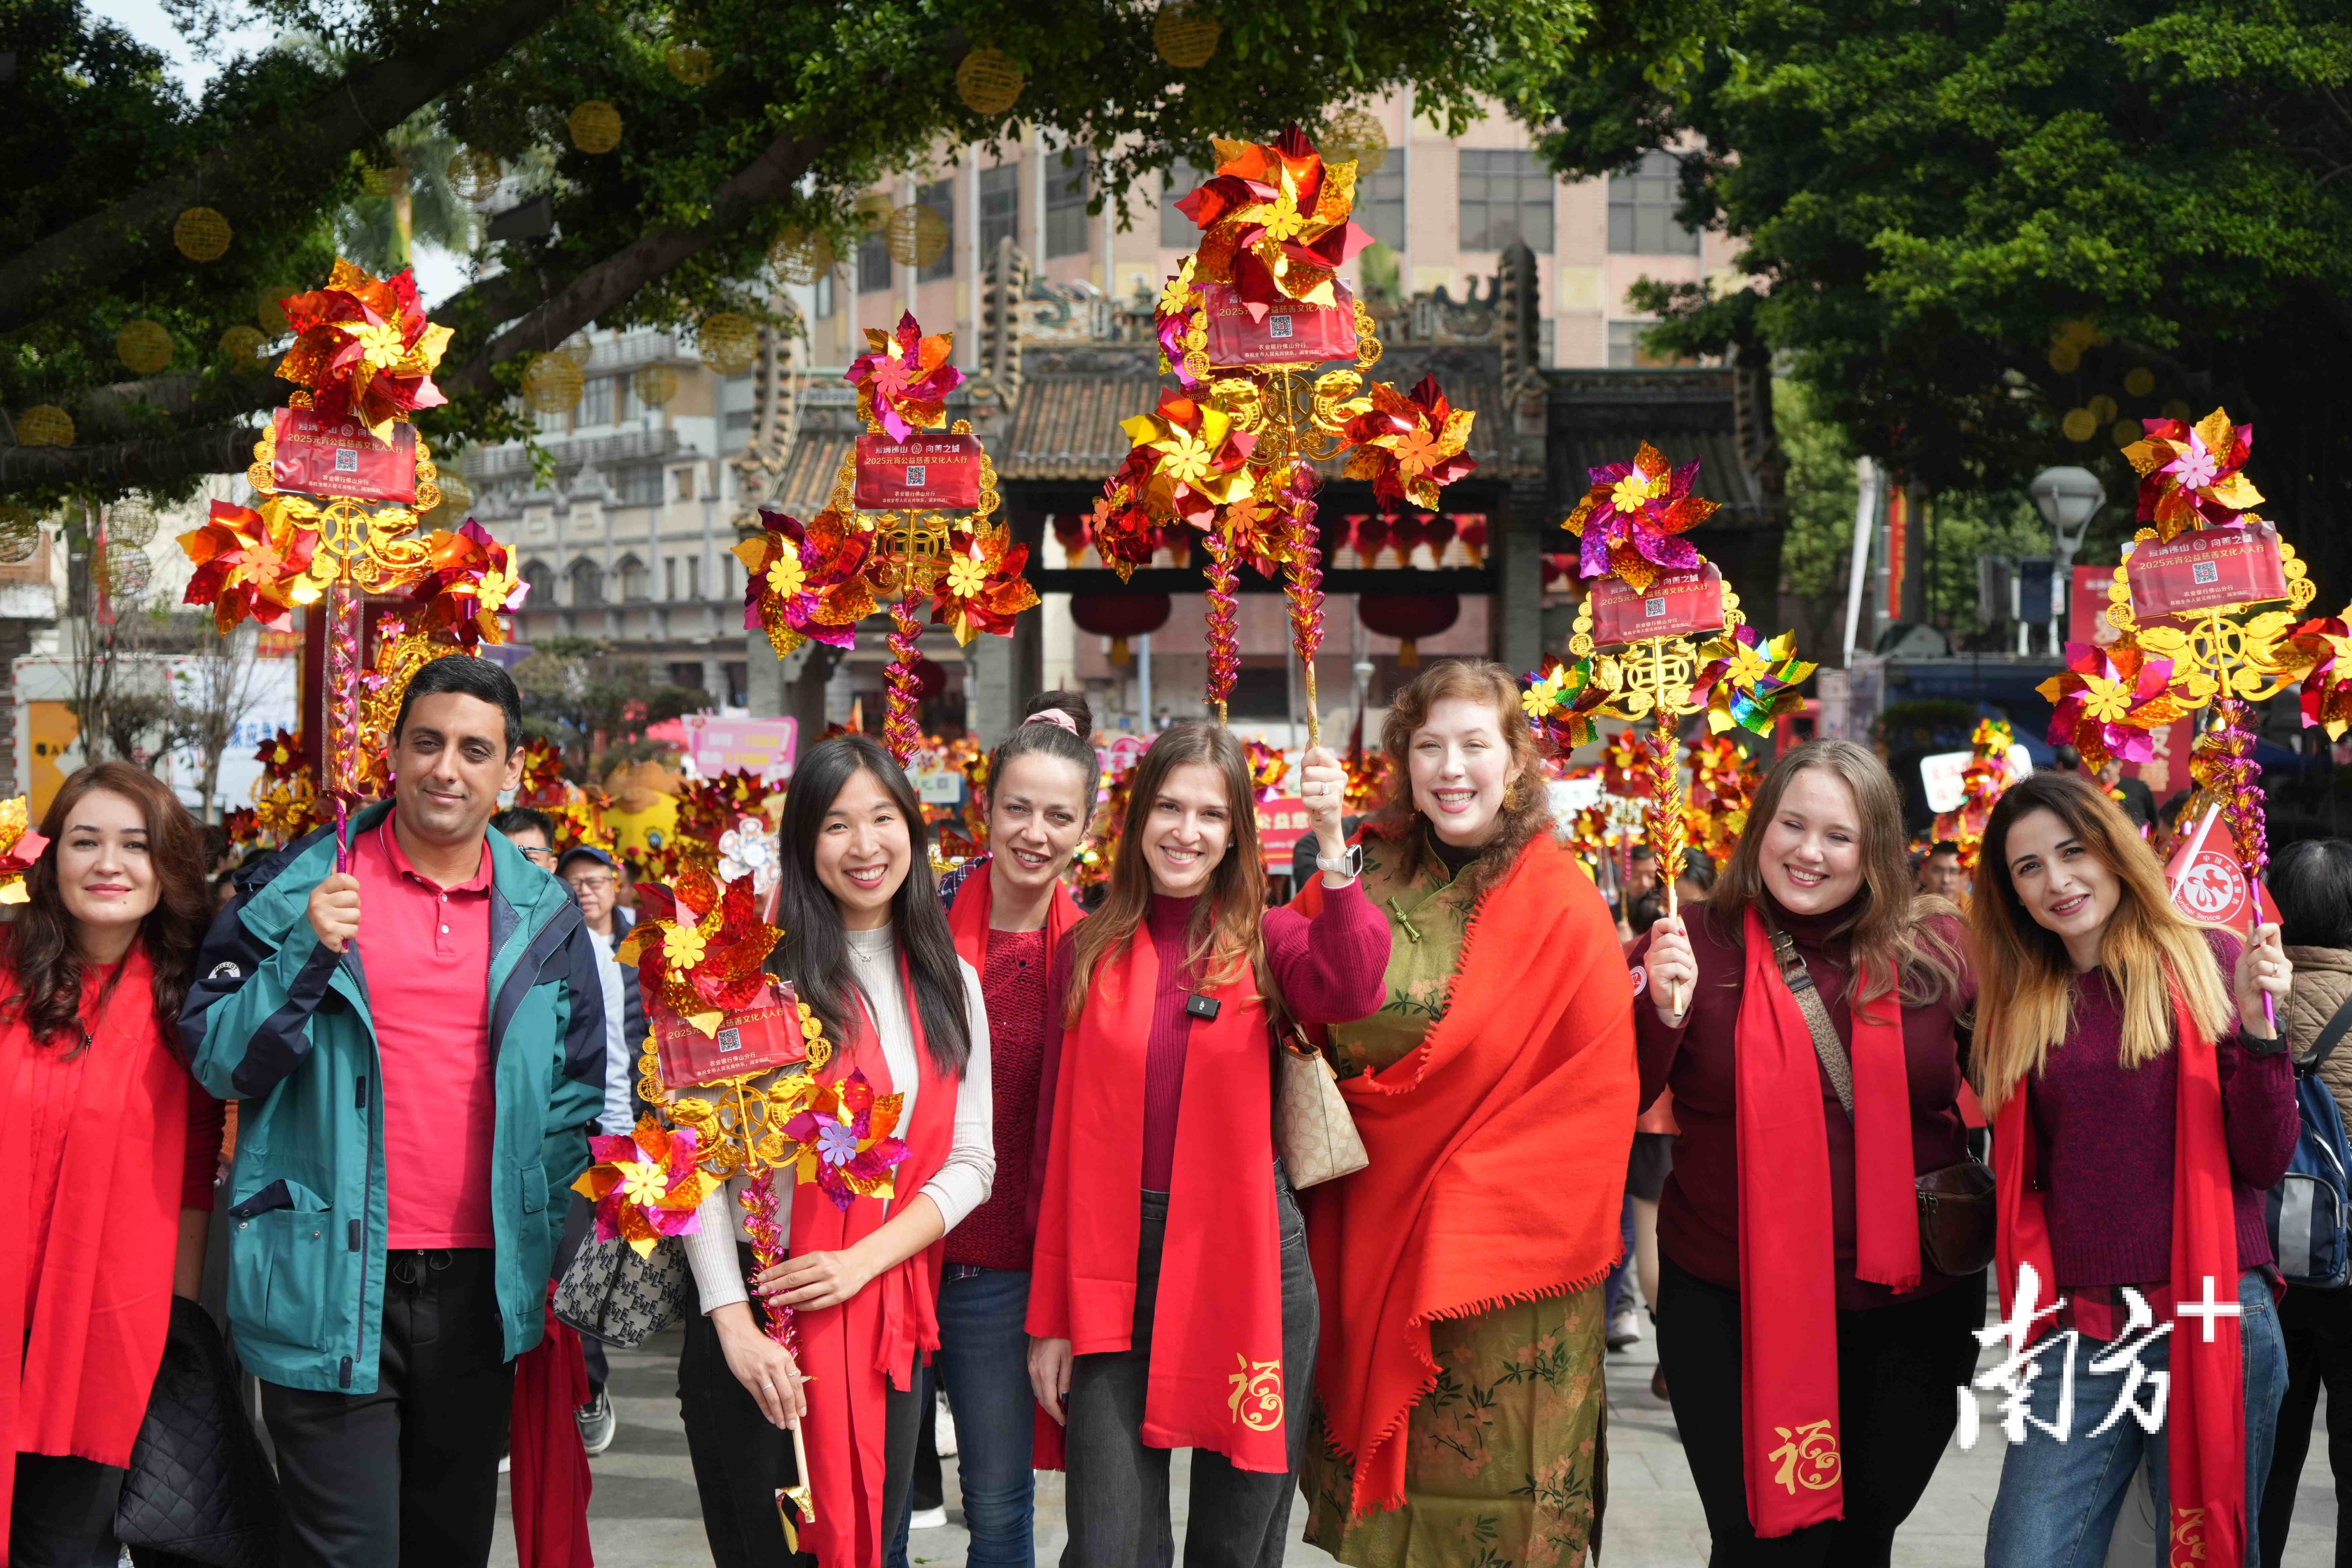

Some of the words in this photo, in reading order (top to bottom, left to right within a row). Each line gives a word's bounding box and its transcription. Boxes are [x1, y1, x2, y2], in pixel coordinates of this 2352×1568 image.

[1189, 357, 1204, 372] 福
[298, 422, 337, 434] 爱满山
[875, 445, 908, 454] 爱满佛山
[926, 443, 960, 453] 向善之城
[866, 456, 967, 465] 2025元宵公益慈善文化人人行
[322, 475, 369, 485] 农业银行佛山分行
[2148, 543, 2189, 557] 爱满佛山
[2211, 534, 2253, 548] 向善之城
[2140, 544, 2265, 570] 2025元宵公益慈善文化人人行
[1663, 574, 1699, 585] 向善之城
[2184, 584, 2233, 597] 农业银行佛山分行
[2111, 608, 2128, 623] 福
[1635, 618, 1678, 628] 农业银行佛山分行
[2175, 891, 2194, 915] olunteer
[214, 962, 238, 972] PELLIOT
[709, 1052, 757, 1066] 农业银行佛山分行
[1228, 1352, 1284, 1432] 福
[1768, 1419, 1842, 1495] 福
